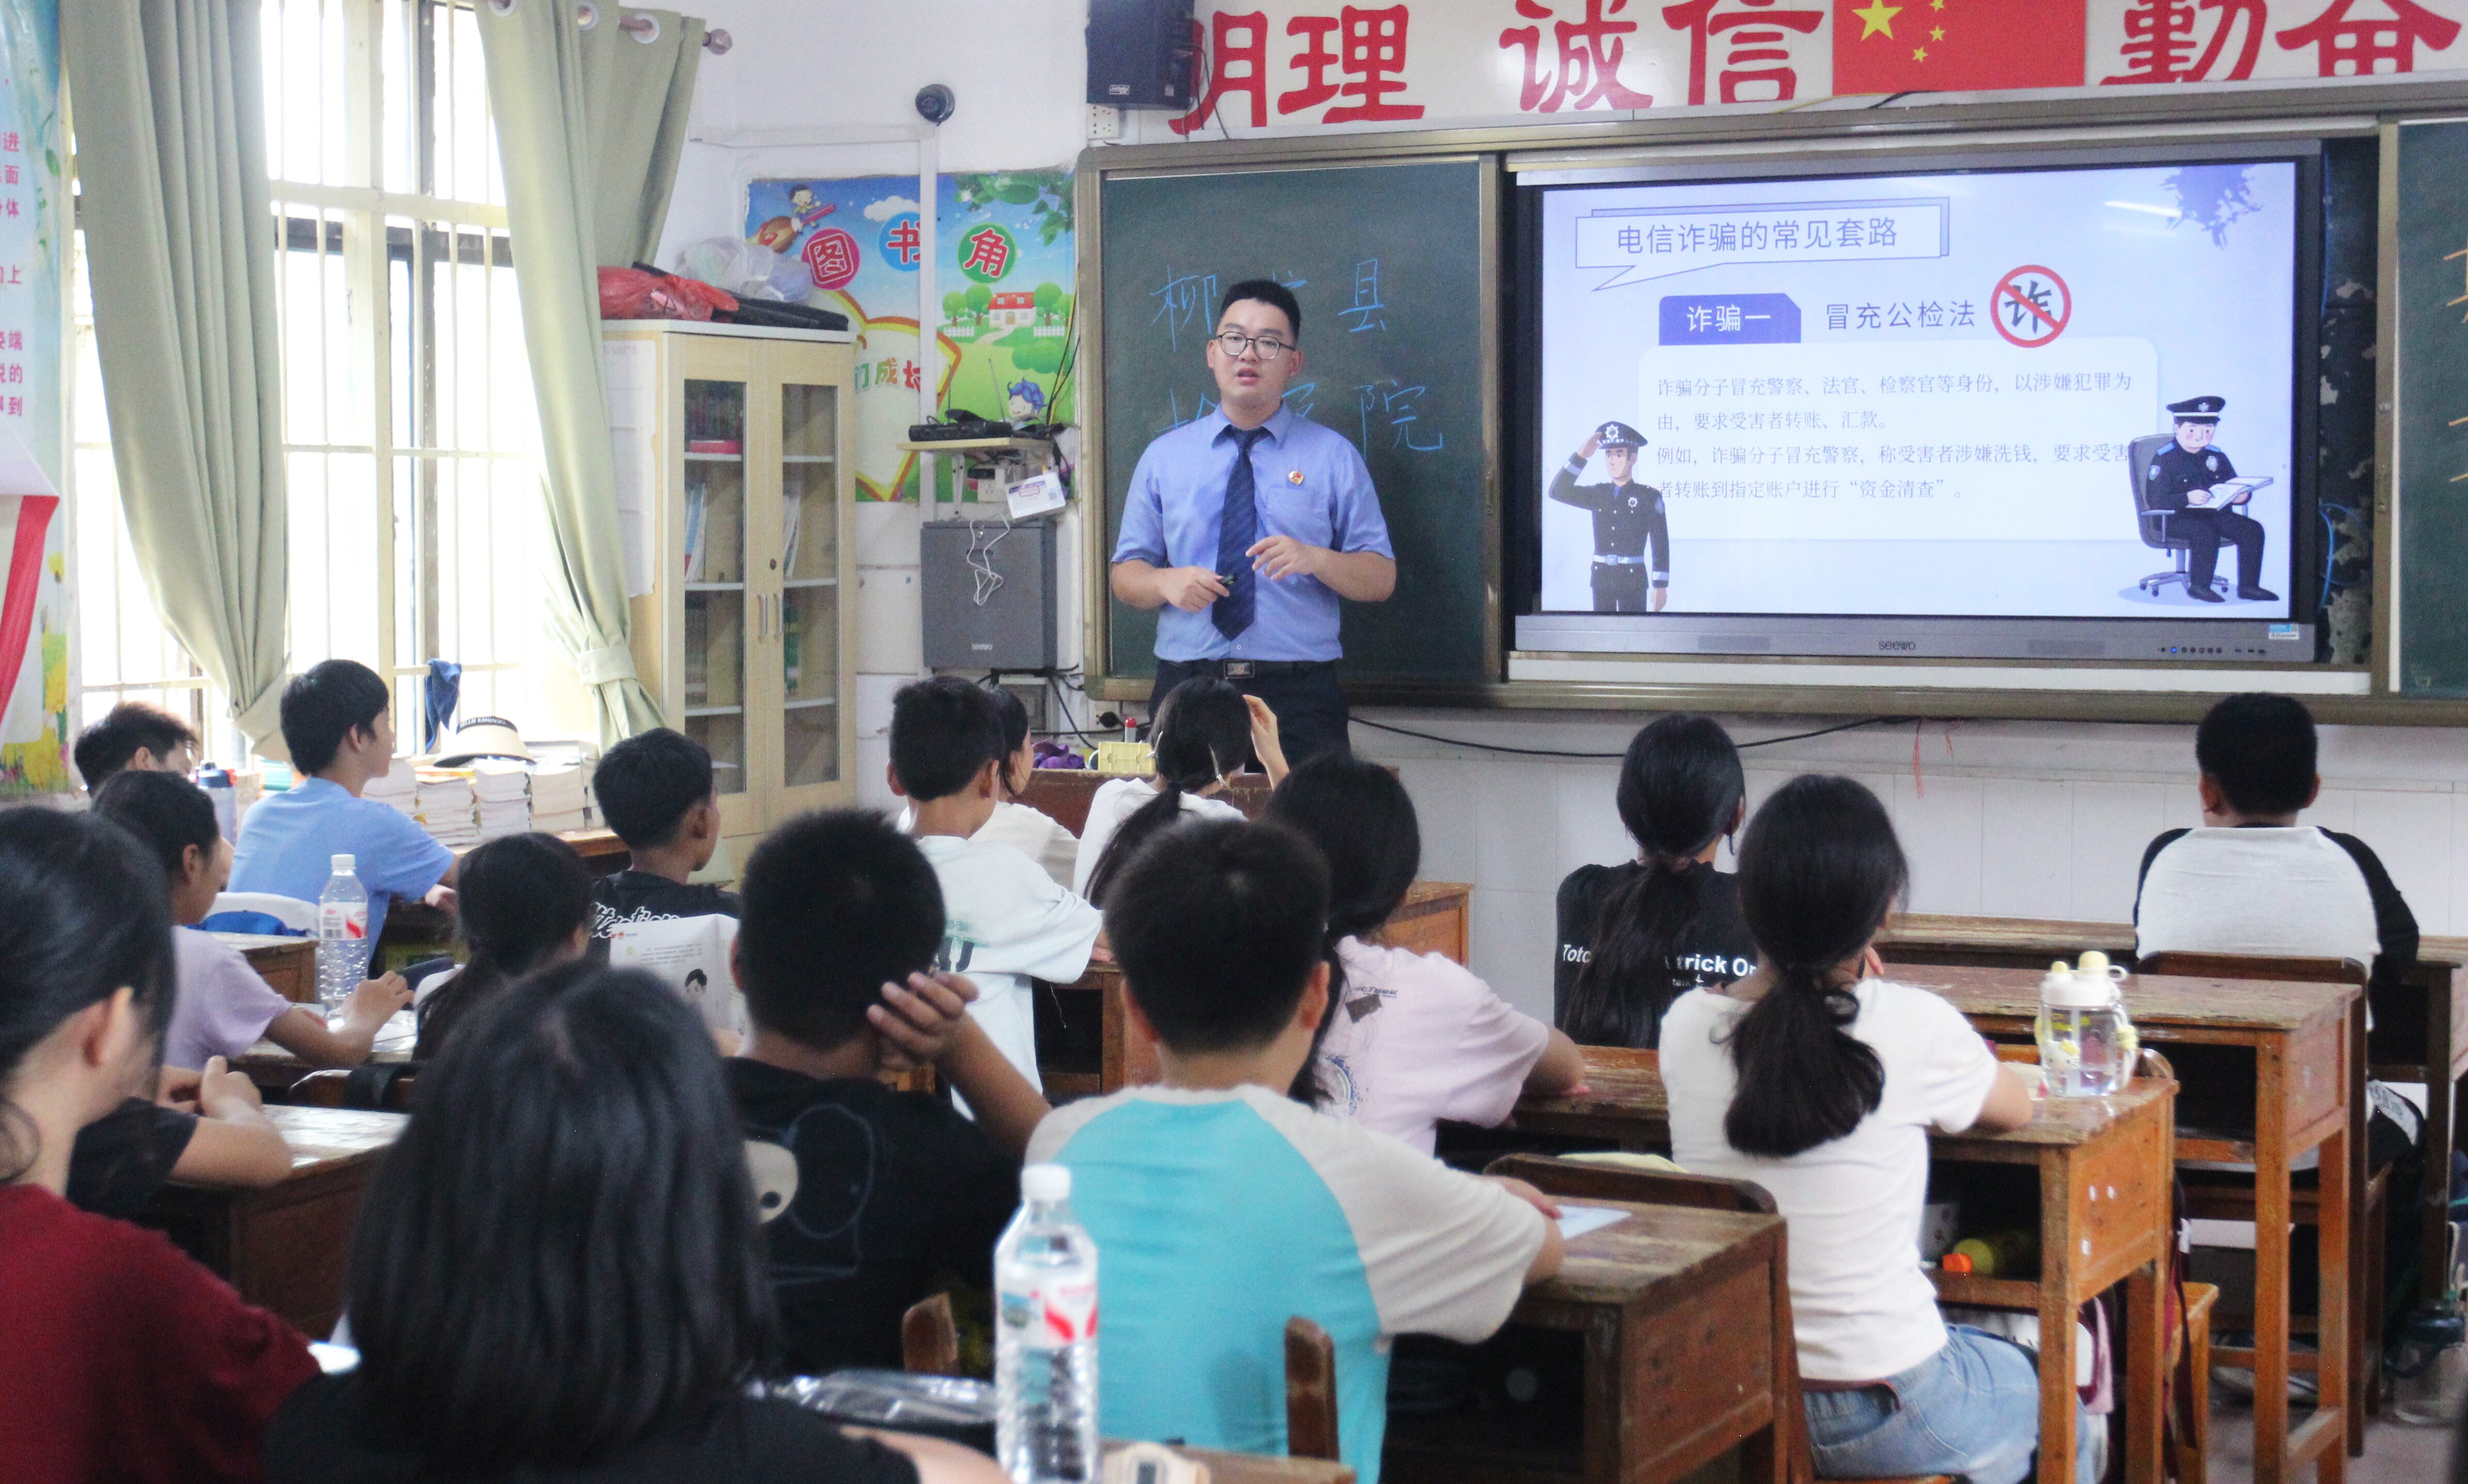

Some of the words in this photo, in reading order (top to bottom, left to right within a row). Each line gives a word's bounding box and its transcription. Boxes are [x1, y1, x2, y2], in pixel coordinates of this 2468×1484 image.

[807, 220, 1008, 286] 图书角
[1617, 216, 1898, 255] 电信诈骗的常见套路
[1687, 304, 1771, 332] 诈骗一
[1826, 300, 1975, 330] 冒充公检法
[1879, 641, 1916, 650] seewo
